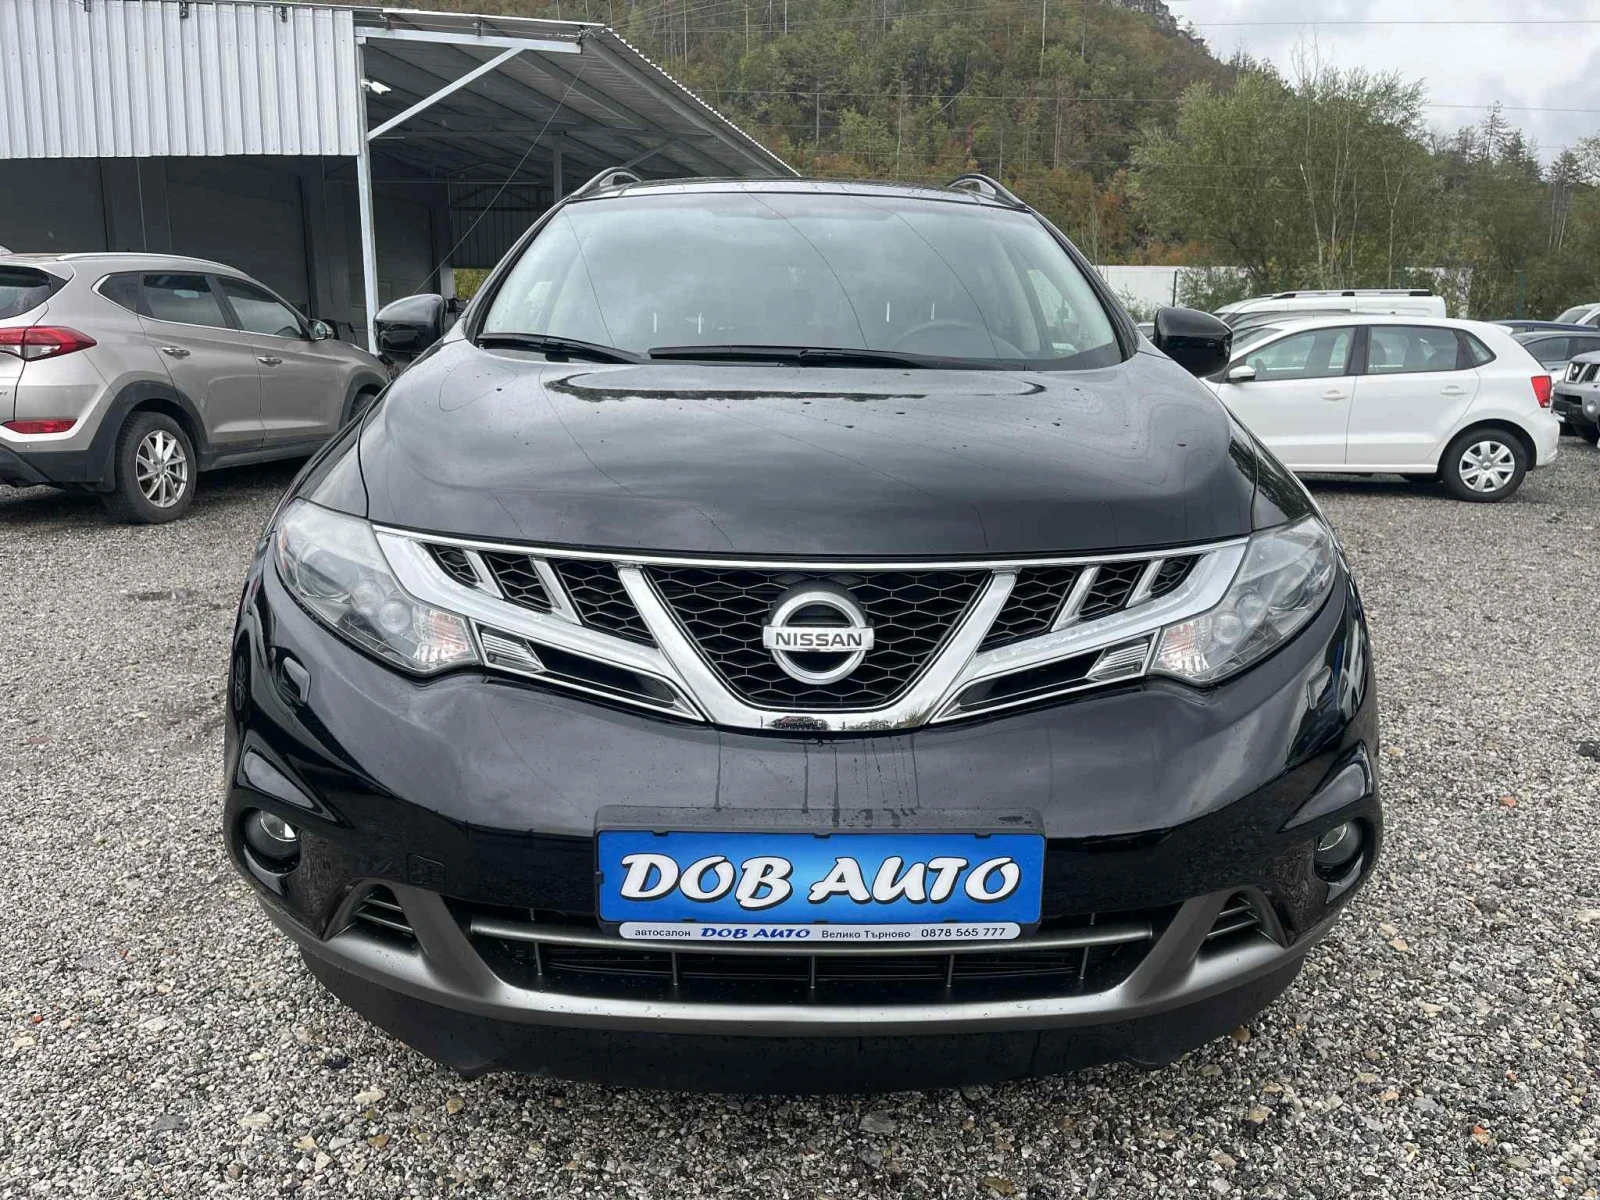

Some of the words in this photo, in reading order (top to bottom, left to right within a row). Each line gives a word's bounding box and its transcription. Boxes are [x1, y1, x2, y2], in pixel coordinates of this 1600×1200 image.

[775, 632, 862, 647] NISSAN
[620, 852, 793, 911] DOB
[808, 856, 1021, 905] AUTO
[634, 928, 691, 937] автосалон
[701, 927, 748, 939] DOB
[752, 927, 811, 939] AUTO
[821, 929, 861, 939] Велико
[864, 930, 911, 940] Търново
[921, 928, 952, 938] 0878
[955, 928, 979, 937] 565
[983, 927, 1006, 937] 777
